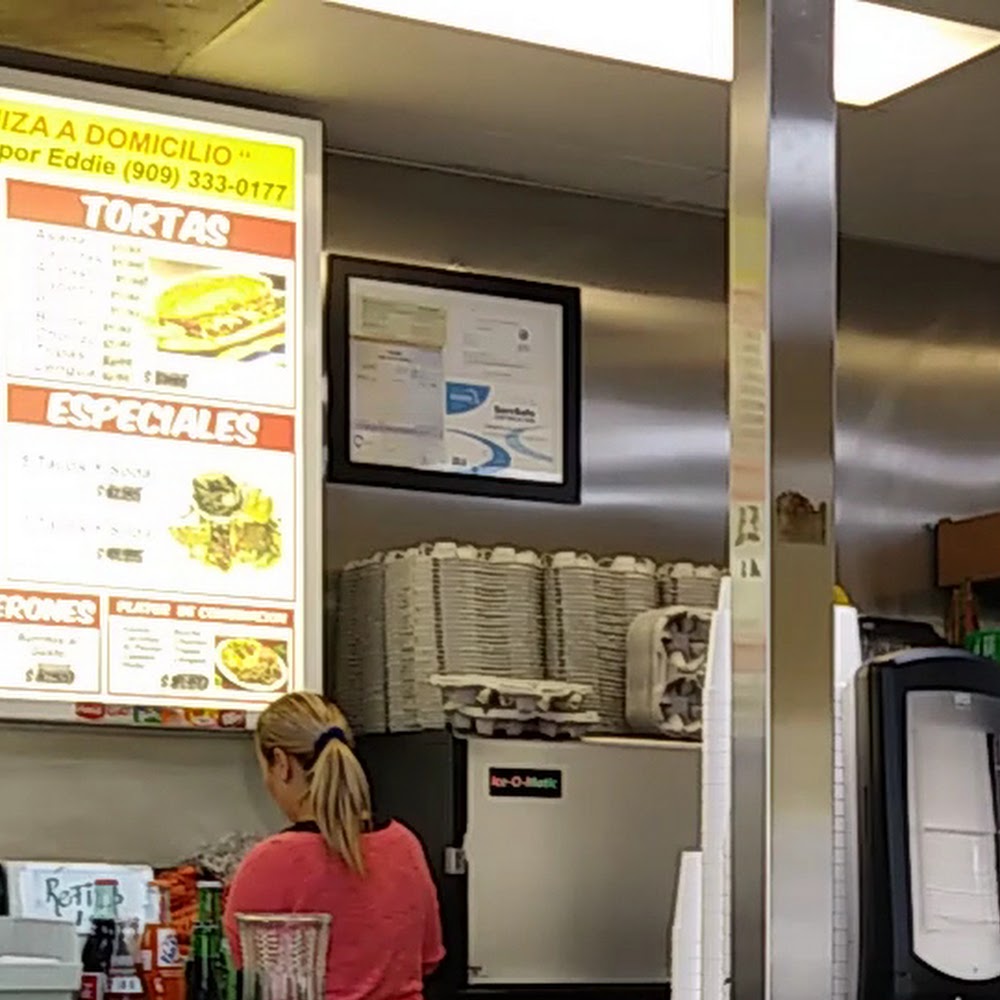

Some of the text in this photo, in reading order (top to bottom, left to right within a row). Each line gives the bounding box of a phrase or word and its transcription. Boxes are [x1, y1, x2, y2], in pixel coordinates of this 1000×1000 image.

[0, 109, 49, 137] IZA
[55, 119, 77, 142] A
[86, 123, 232, 167] DOMICILIO
[0, 144, 288, 202] por Eddie (909) 333-0177
[78, 194, 231, 248] TORTAS
[46, 391, 261, 446] ESPECIALES
